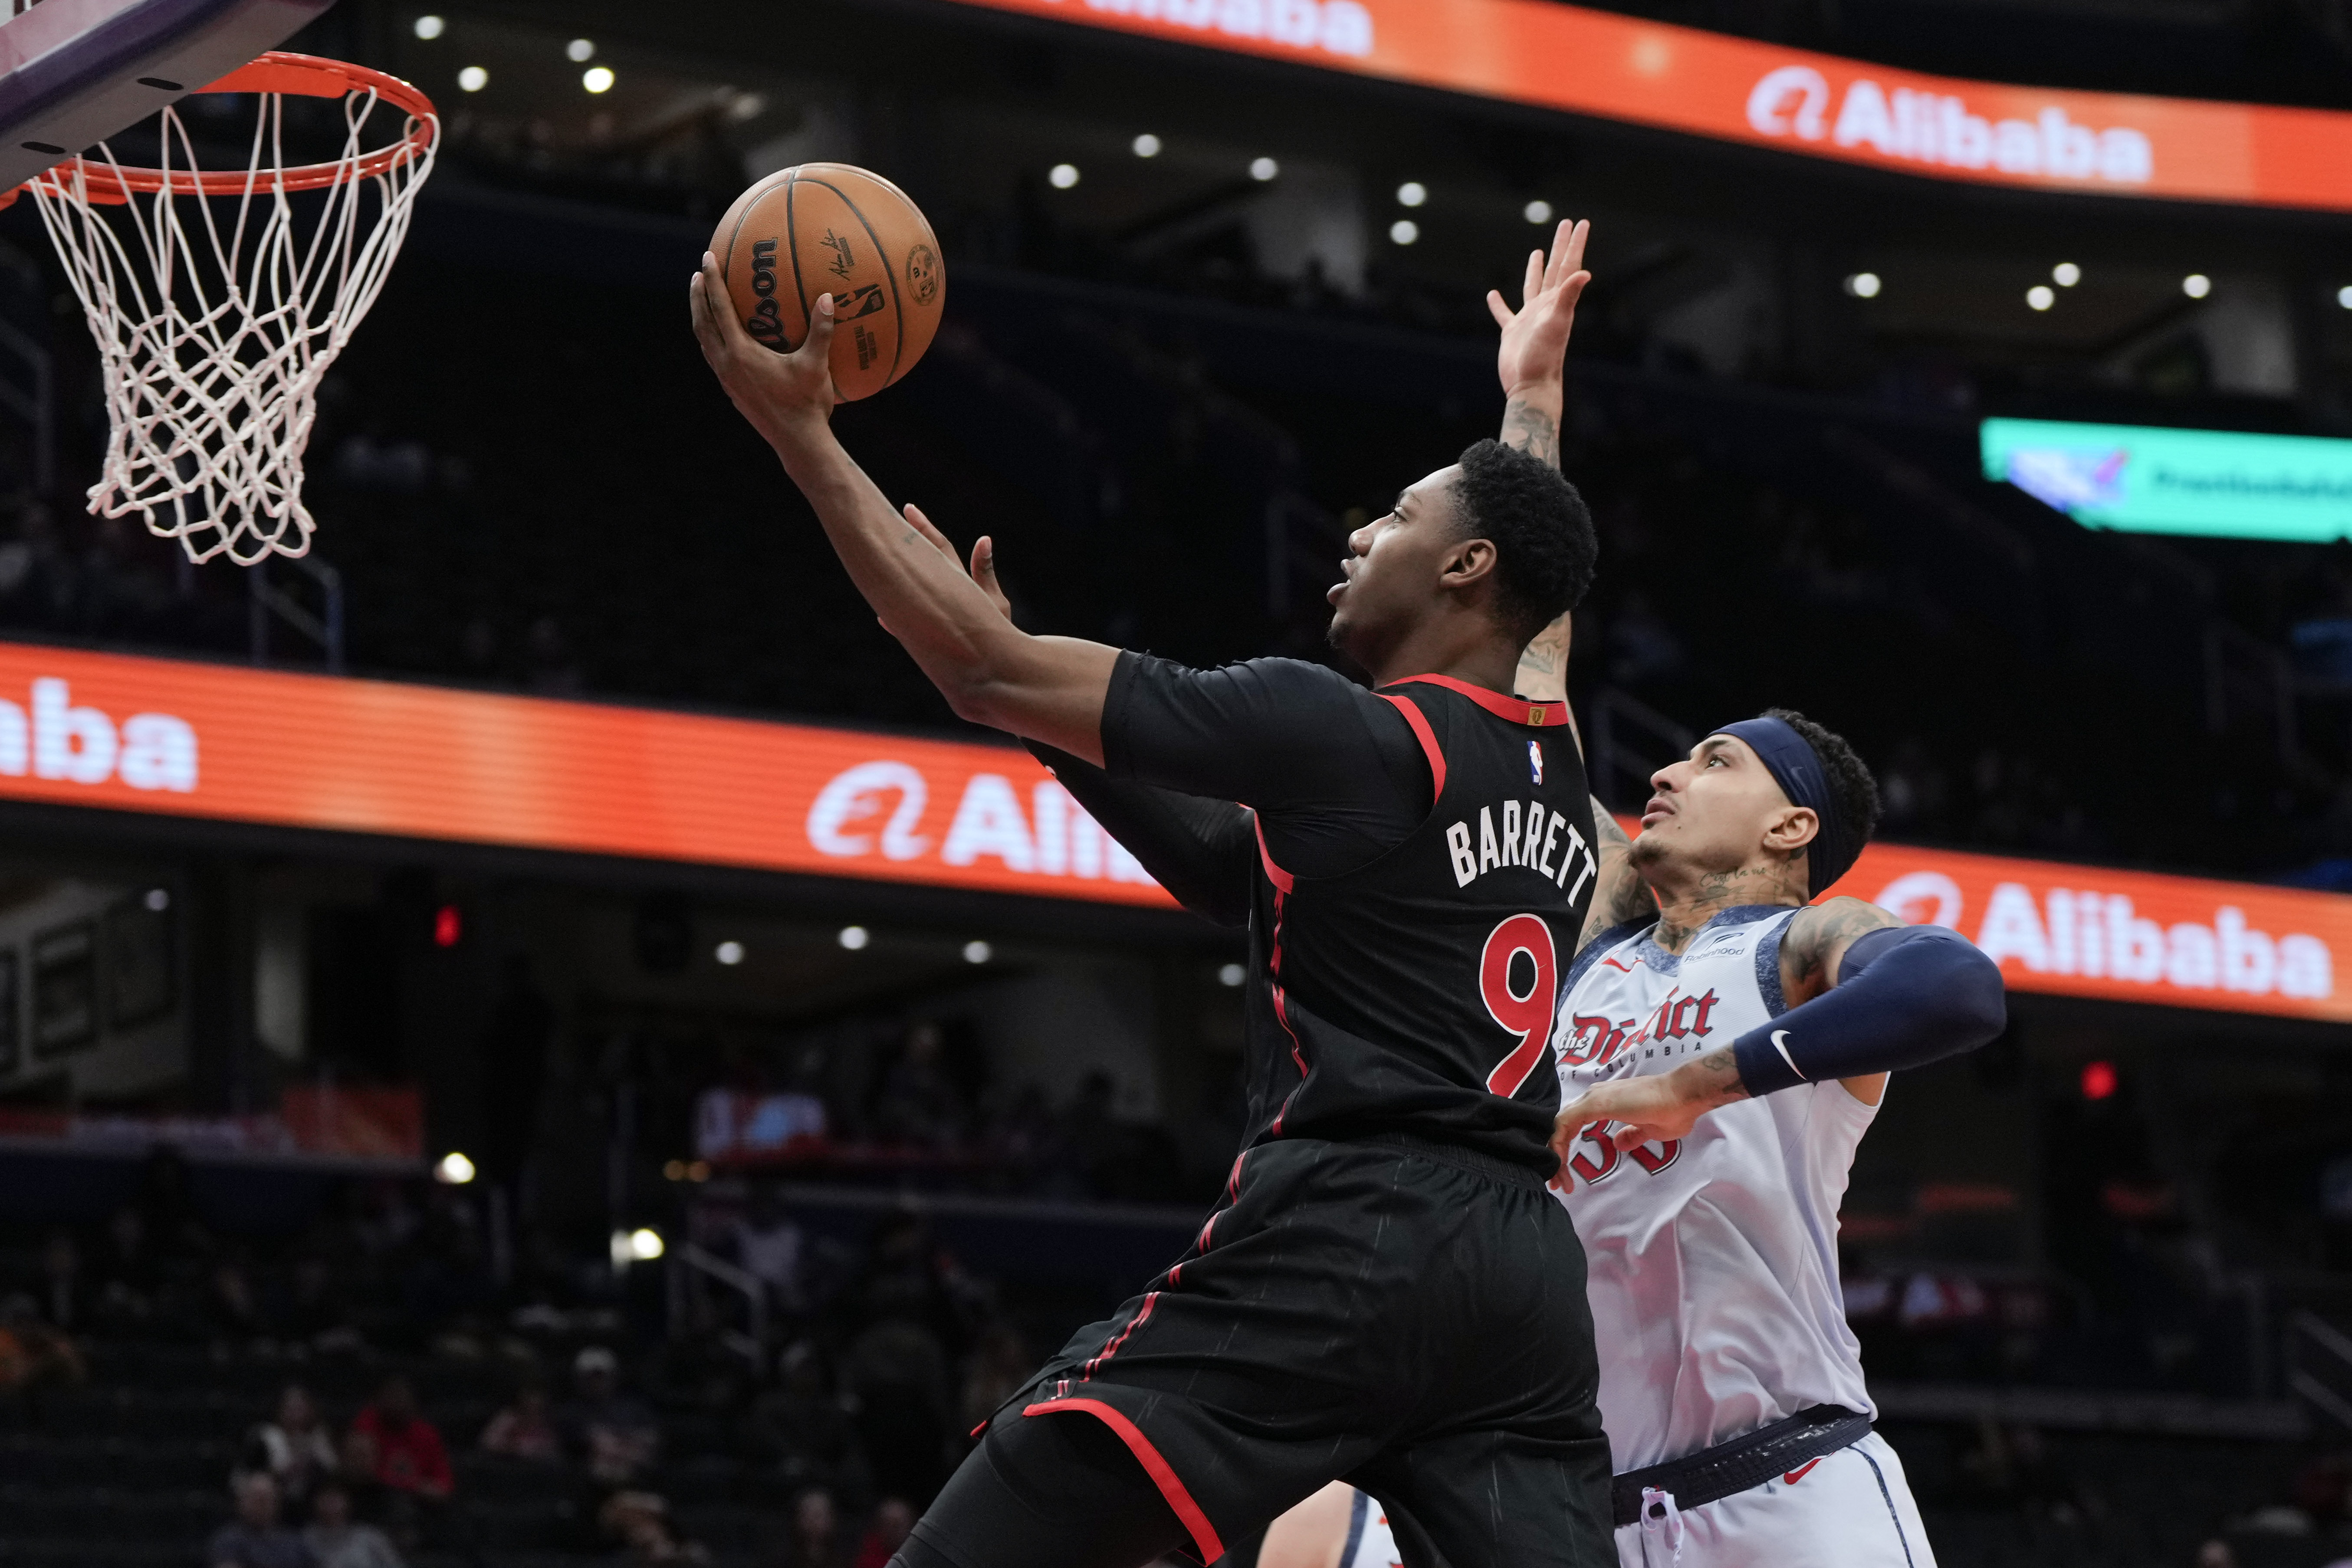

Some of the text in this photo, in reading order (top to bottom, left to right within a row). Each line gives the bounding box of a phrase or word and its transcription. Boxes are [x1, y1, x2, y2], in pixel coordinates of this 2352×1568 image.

[1835, 79, 2152, 182] Alibaba
[1446, 799, 1597, 908] BARRETT
[1684, 947, 1745, 963] Robinhood
[1977, 881, 2332, 999] Alibaba
[1479, 913, 1557, 1099] 9
[1558, 1029, 1589, 1052] the
[1560, 1042, 1702, 1081] OF COLUMBIA
